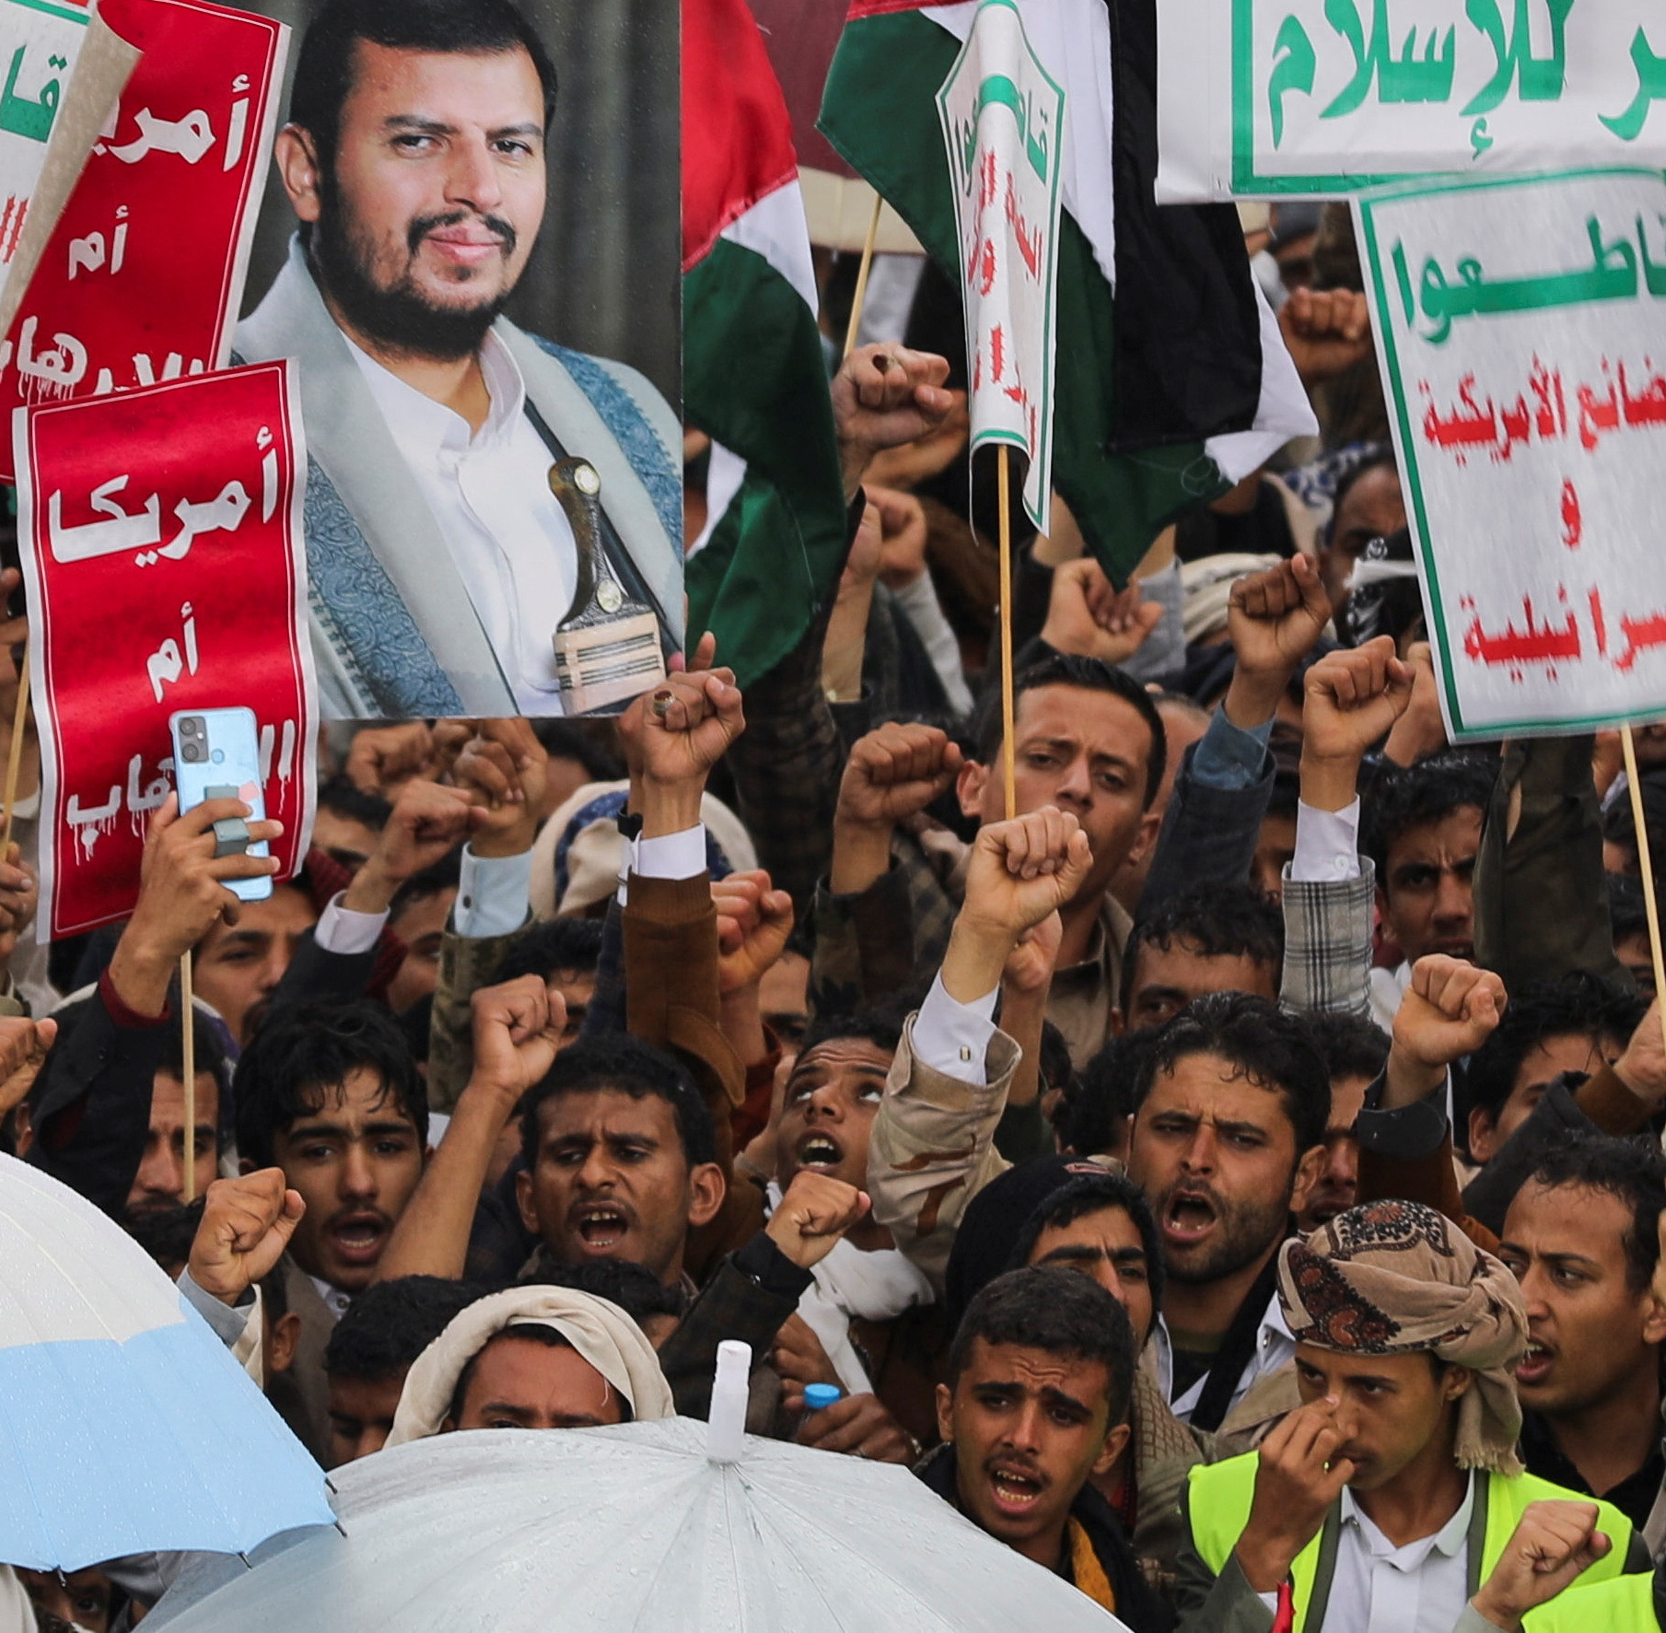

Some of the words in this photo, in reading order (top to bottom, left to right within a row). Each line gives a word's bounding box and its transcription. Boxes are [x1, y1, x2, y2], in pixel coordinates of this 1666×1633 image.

[69, 205, 128, 280] أم
[980, 237, 996, 296] و
[1420, 353, 1567, 469] الأمريكية
[48, 426, 279, 568] أمريكا
[1561, 476, 1582, 548] و
[146, 600, 199, 703] أم
